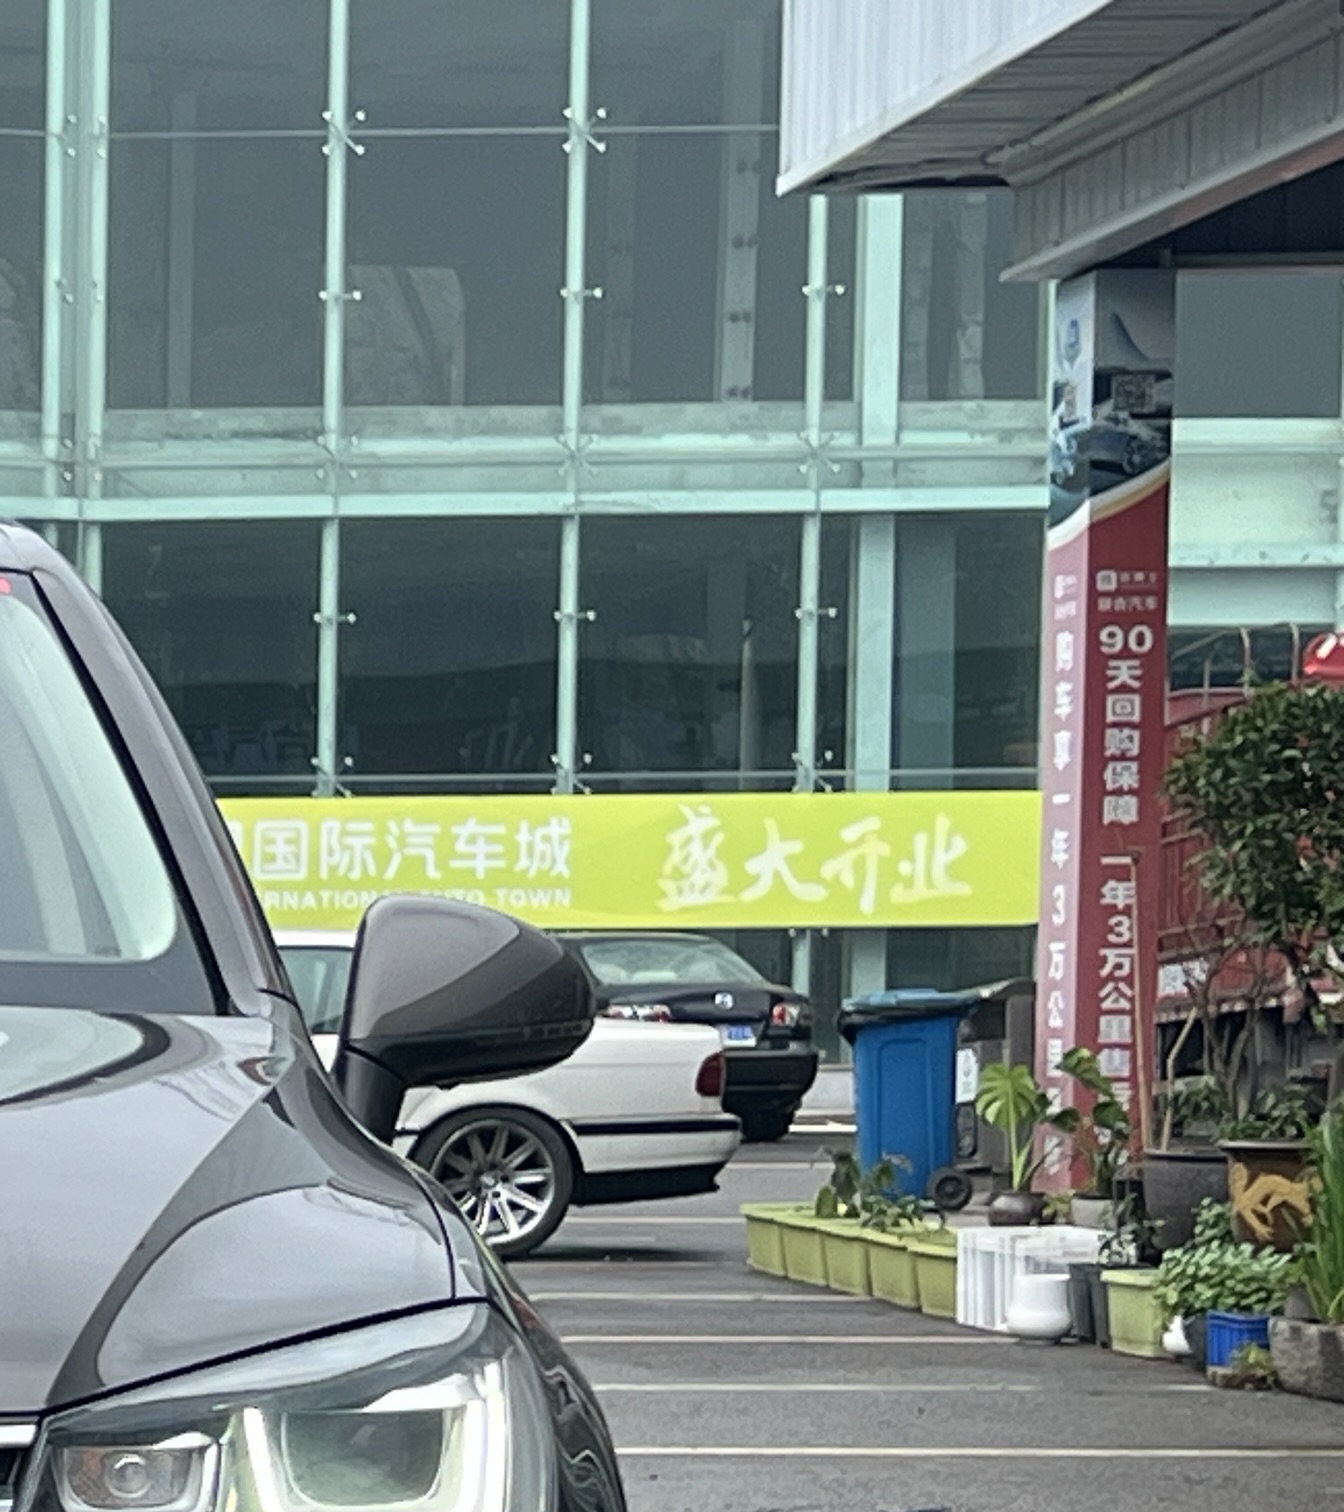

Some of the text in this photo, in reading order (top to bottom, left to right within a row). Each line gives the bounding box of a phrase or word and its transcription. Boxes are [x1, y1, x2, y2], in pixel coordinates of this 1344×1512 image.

[232, 816, 572, 881] 国际汽车城
[655, 803, 973, 916] 盛大开业
[495, 887, 572, 909] TOWN
